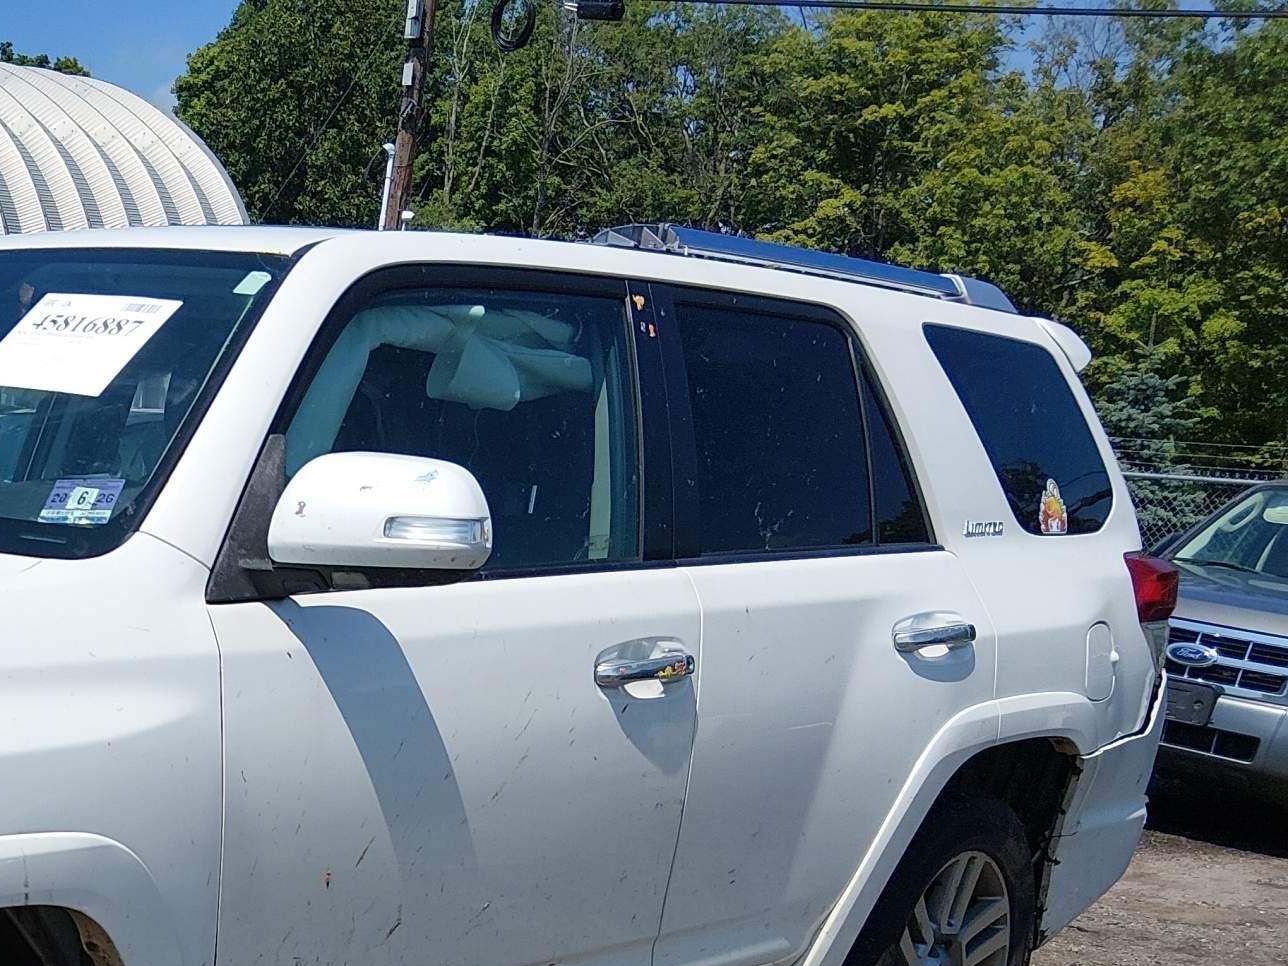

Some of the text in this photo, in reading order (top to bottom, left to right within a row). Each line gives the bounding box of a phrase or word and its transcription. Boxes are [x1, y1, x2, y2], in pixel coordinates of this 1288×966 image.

[32, 314, 144, 337] 45816887
[77, 490, 89, 505] 6
[1176, 647, 1203, 660] Ford
